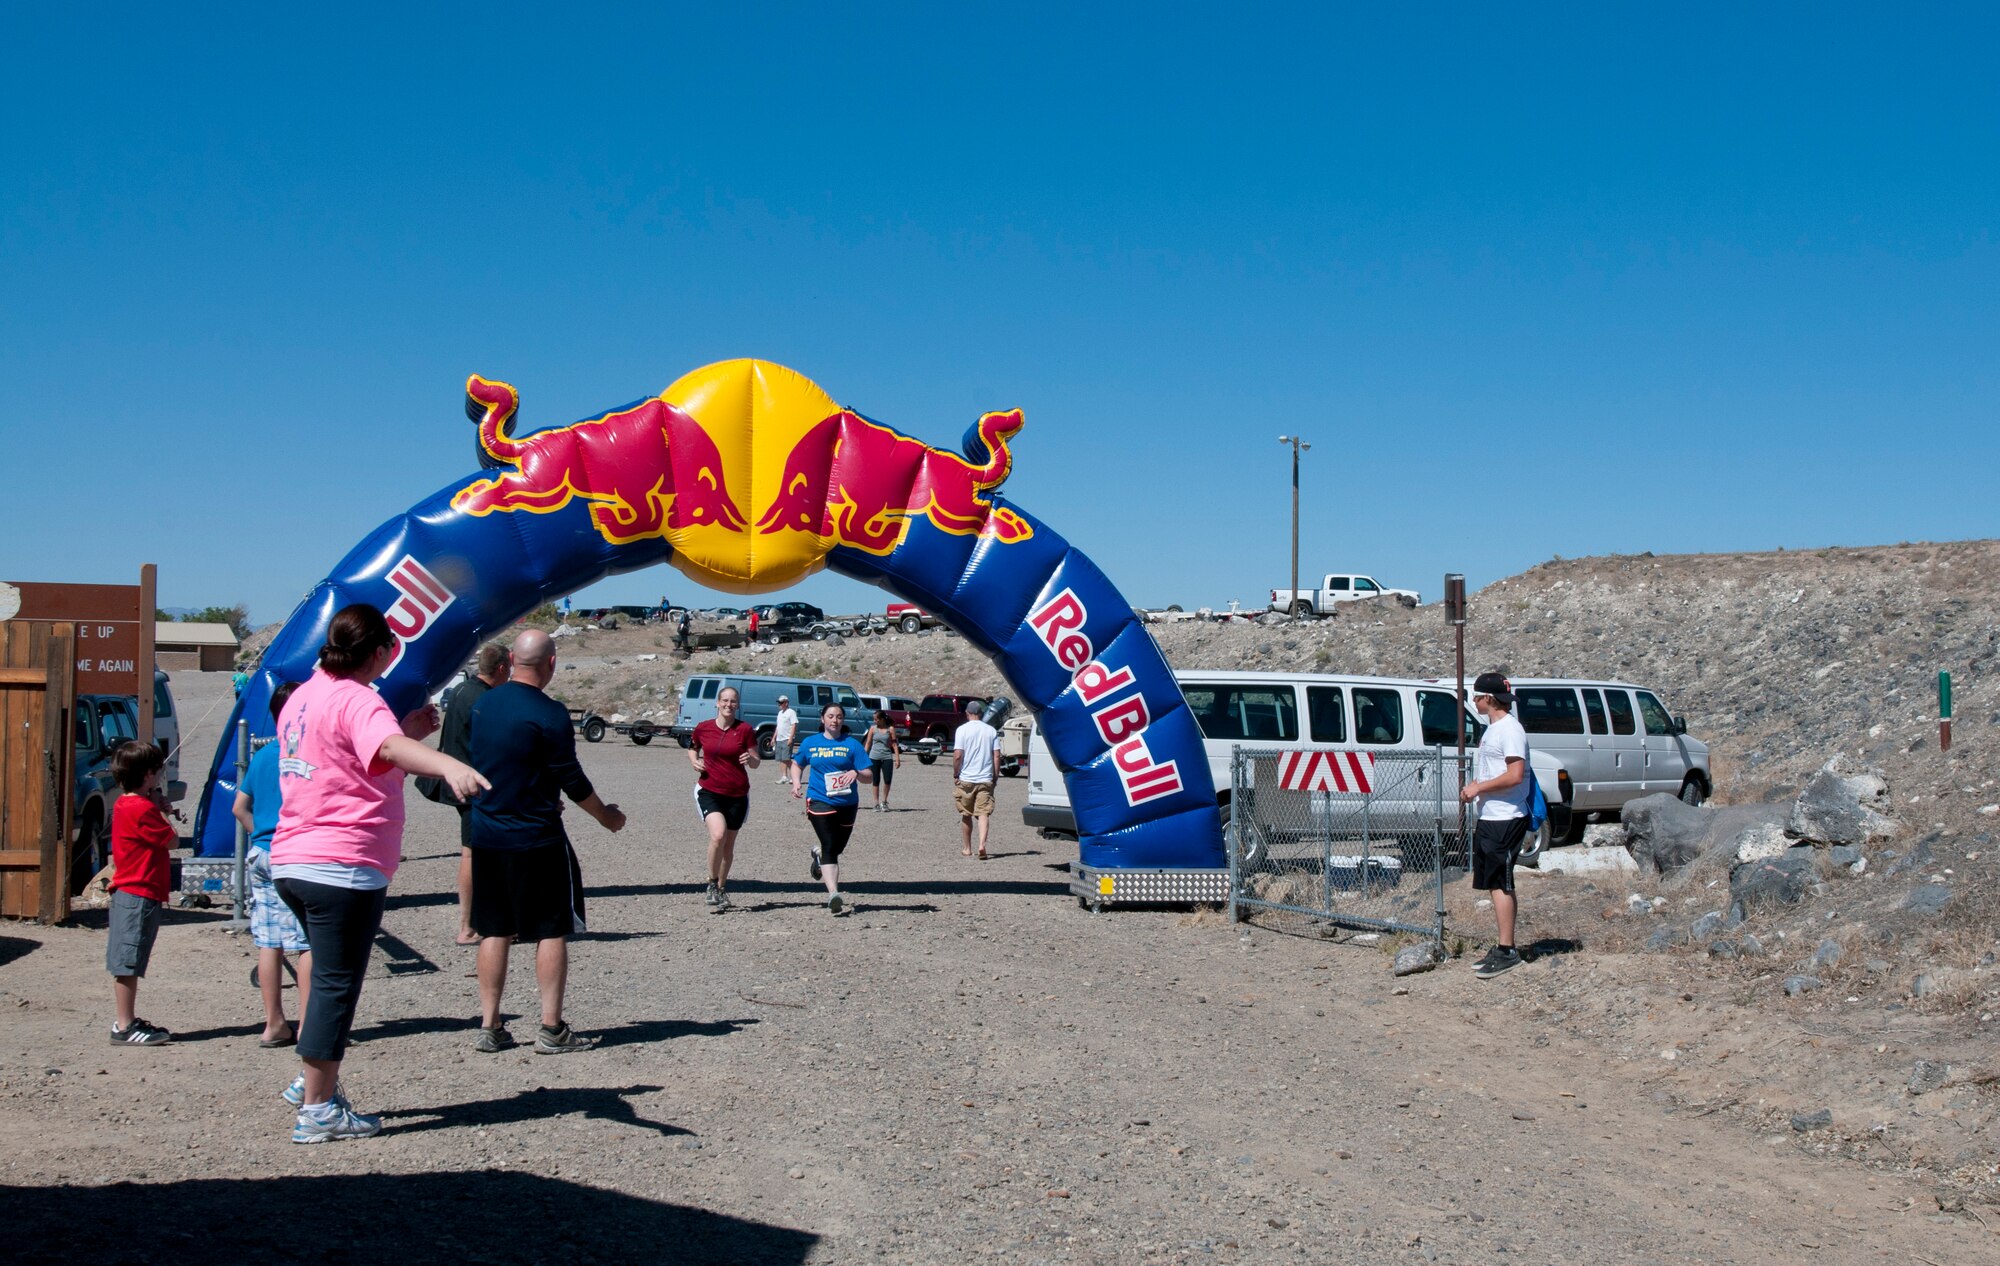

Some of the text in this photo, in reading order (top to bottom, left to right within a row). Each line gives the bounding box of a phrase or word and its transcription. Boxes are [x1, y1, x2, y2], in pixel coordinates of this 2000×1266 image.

[78, 625, 114, 639] E UP
[98, 659, 134, 673] AGAIN
[1028, 589, 1182, 805] Red Bull
